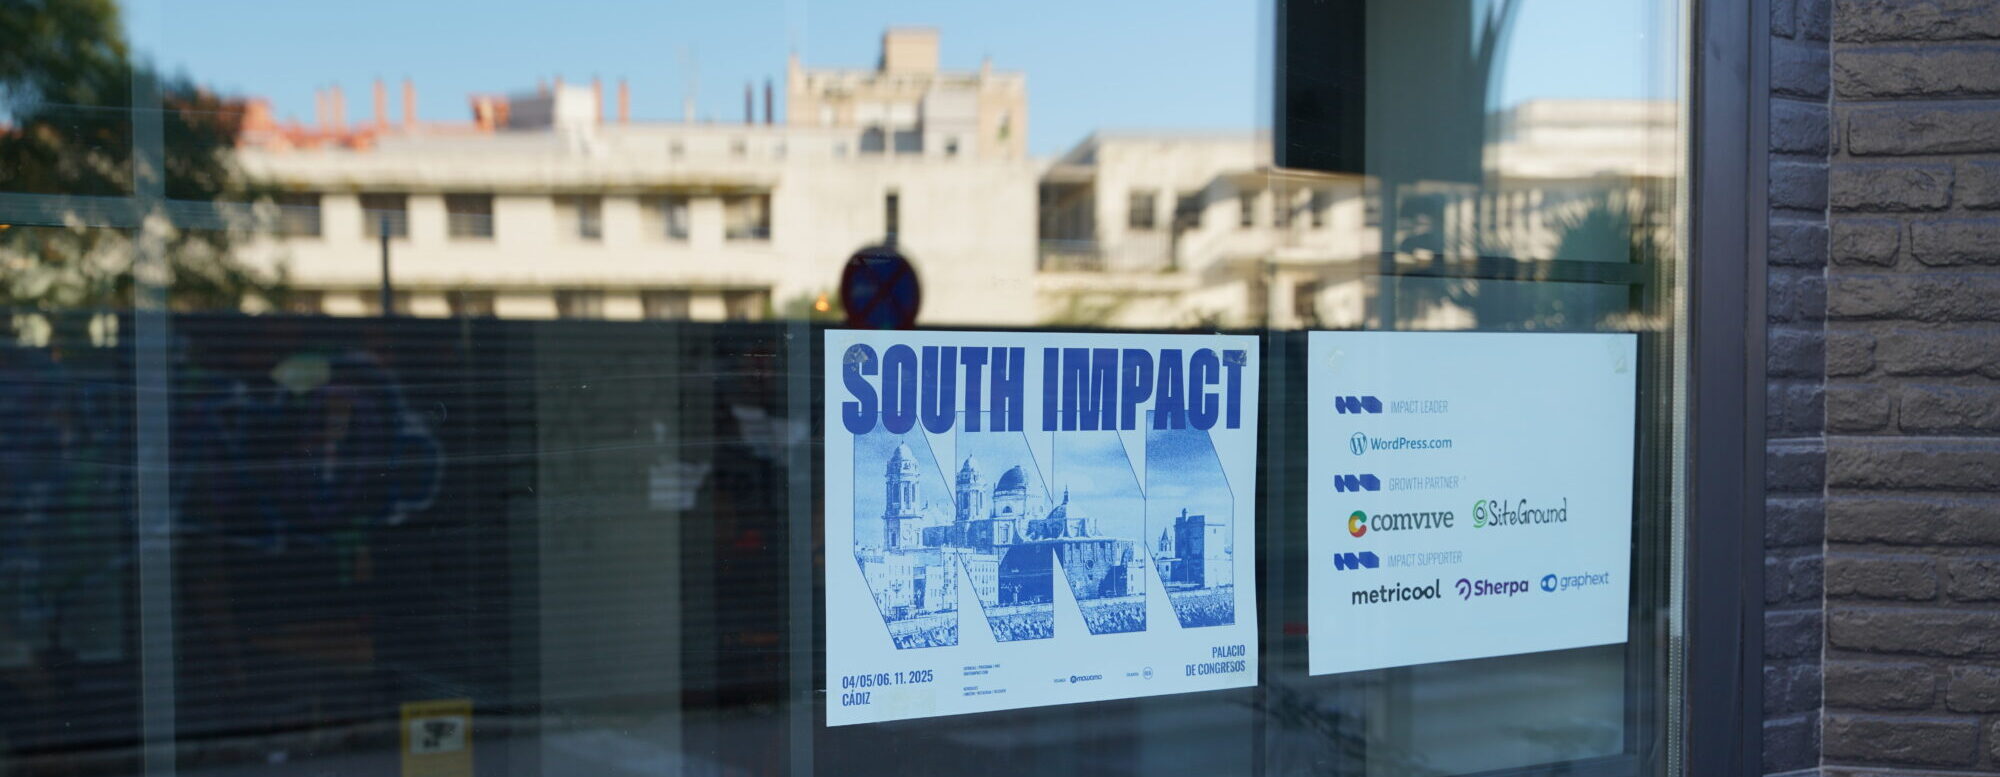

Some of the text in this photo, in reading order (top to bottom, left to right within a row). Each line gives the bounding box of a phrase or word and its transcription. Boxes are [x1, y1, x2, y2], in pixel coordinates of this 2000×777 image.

[842, 343, 1247, 435] SOUTH IMPACT
[1390, 400, 1449, 414] IMPACT LEADER
[1370, 437, 1453, 450] WordPress.com
[1388, 475, 1460, 492] GROWTH PARTNER
[1371, 510, 1454, 532] comvive
[1488, 497, 1568, 527] SiteGround
[1387, 550, 1463, 568] IMPACT SUPPORTER
[1474, 579, 1529, 597] Sherpa
[1560, 571, 1609, 592] graphext
[1352, 578, 1441, 605] metricool
[1212, 644, 1246, 658] PALACIO
[1185, 660, 1246, 677] DE CONGRESOS
[842, 669, 934, 689] 04/05/06. 11. 2025
[842, 689, 871, 707] CÁDIZ
